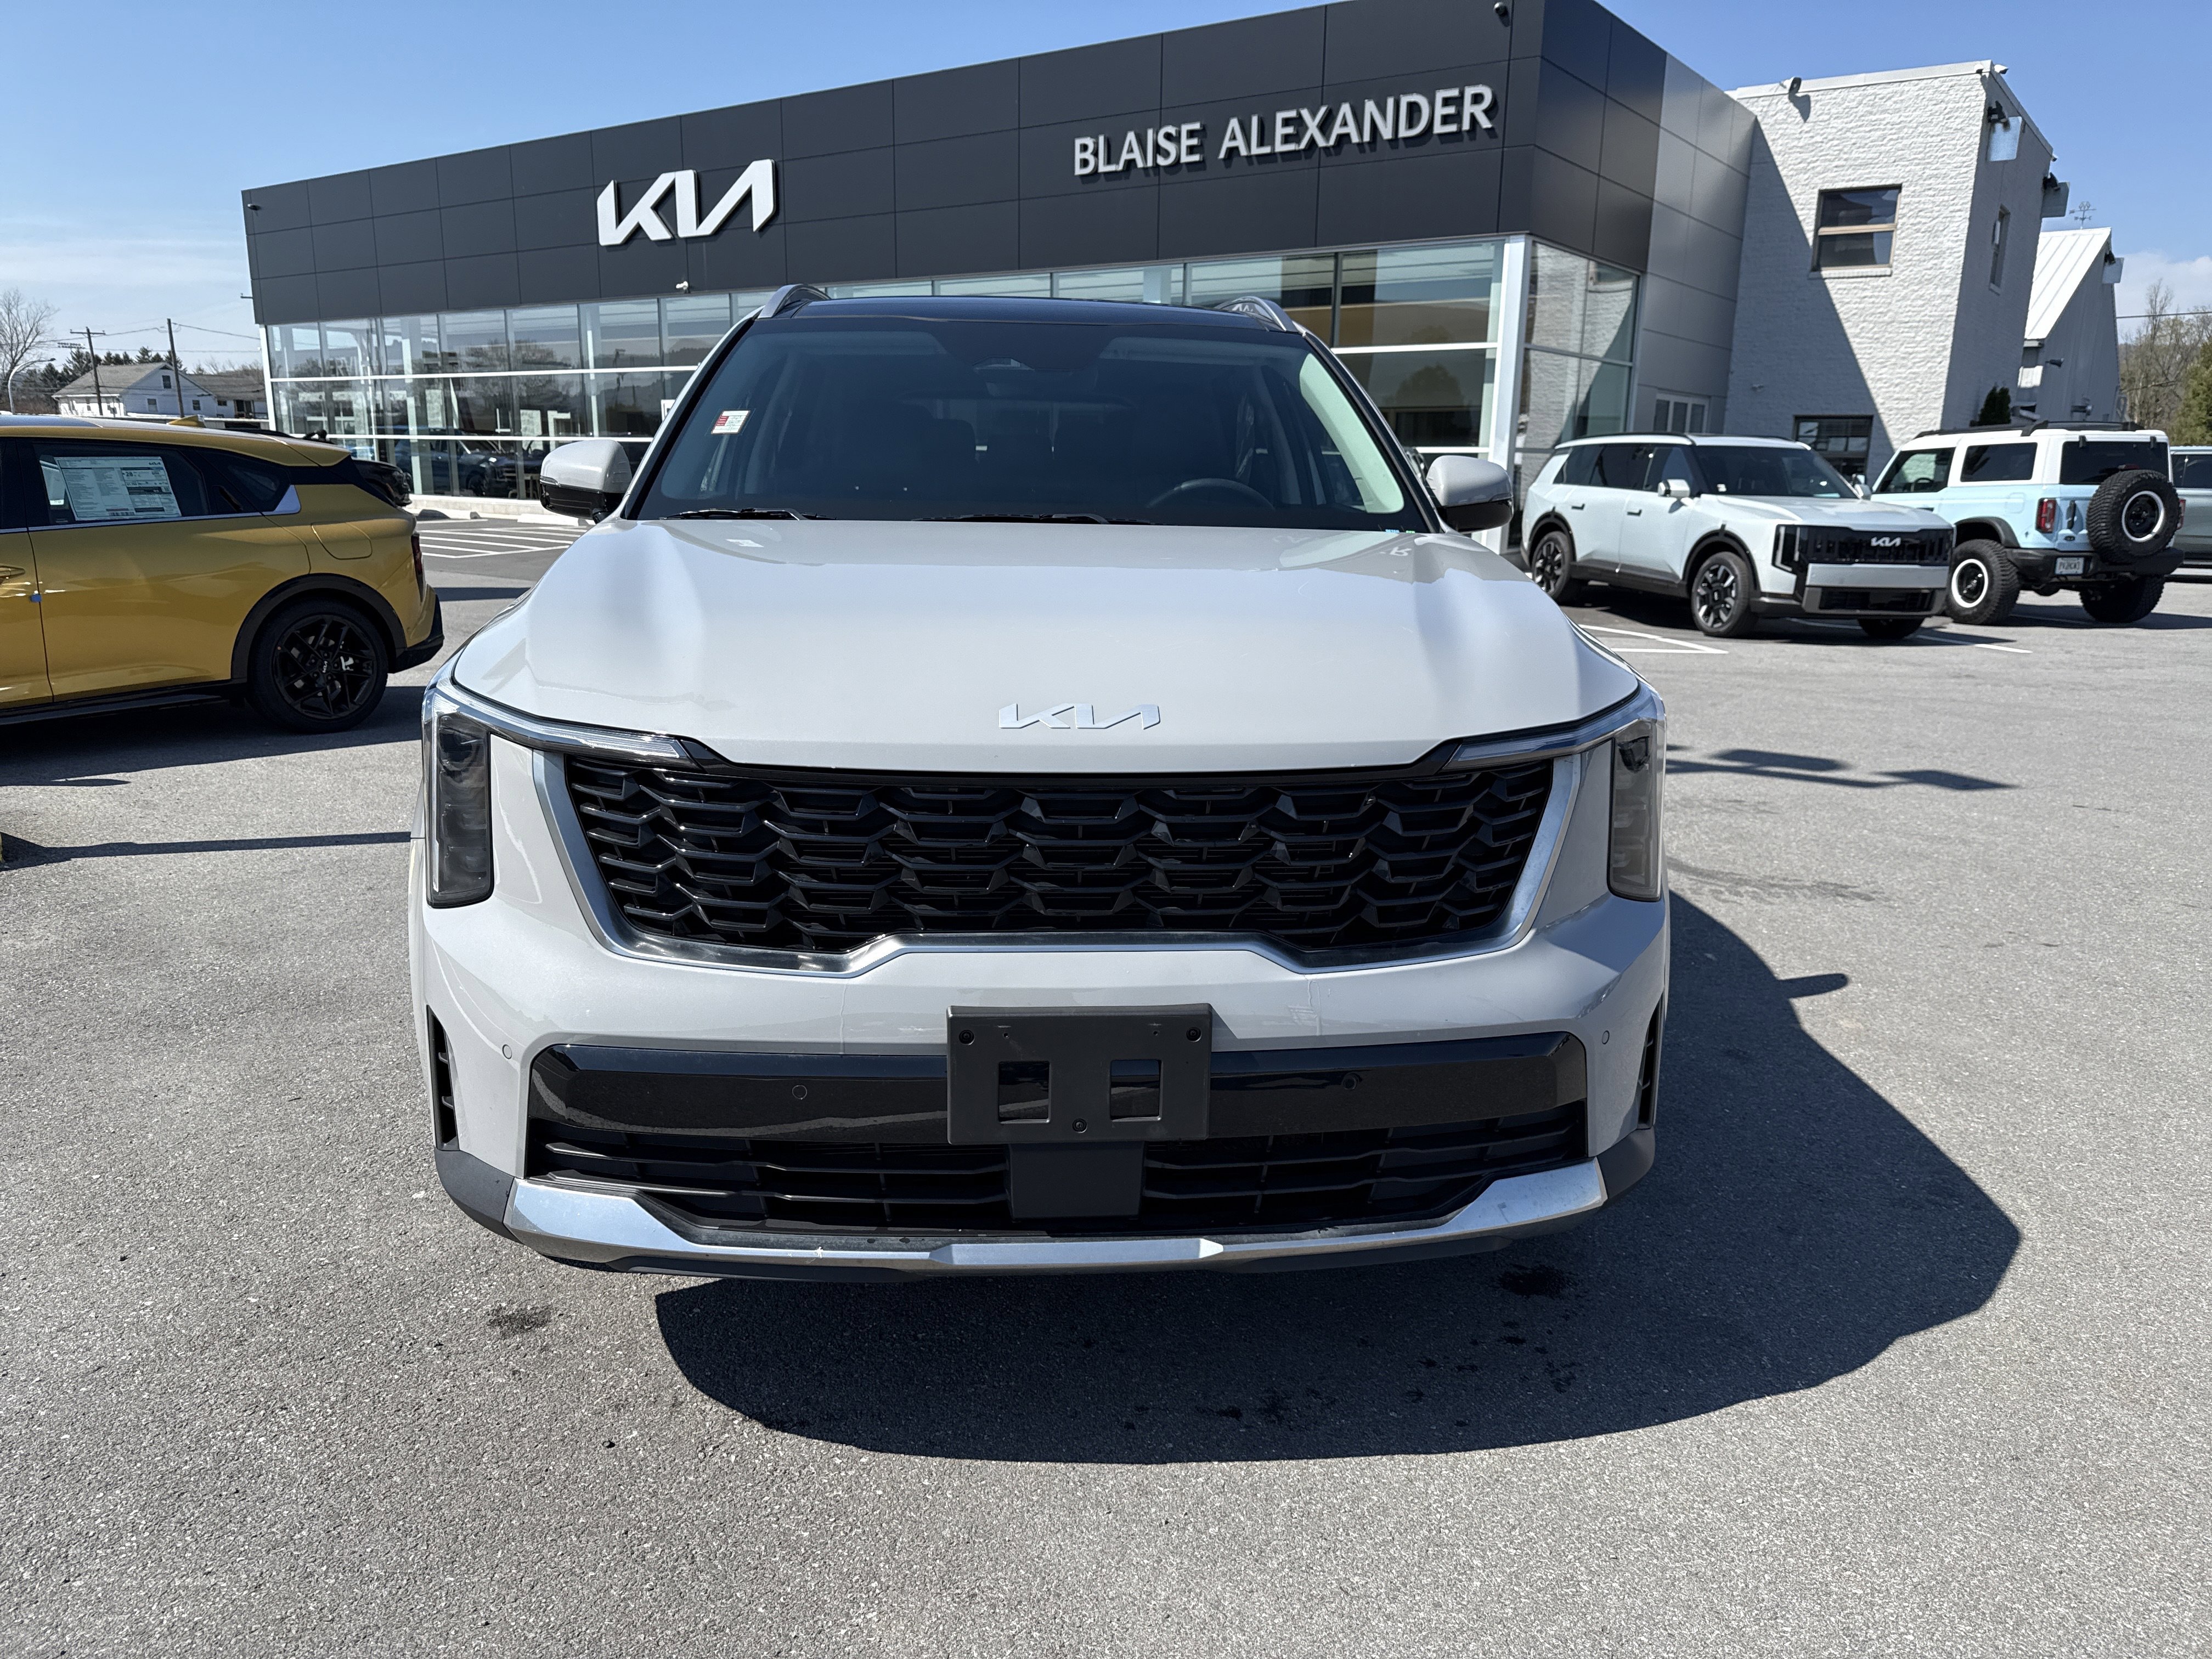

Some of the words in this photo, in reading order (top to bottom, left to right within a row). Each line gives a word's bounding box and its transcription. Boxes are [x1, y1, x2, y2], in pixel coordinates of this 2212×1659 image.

[1074, 122, 1201, 176] BLAISE
[1218, 84, 1494, 159] ALEXANDER
[597, 159, 775, 246] KIA
[1870, 537, 1901, 547] KIA
[998, 703, 1161, 730] KIA
